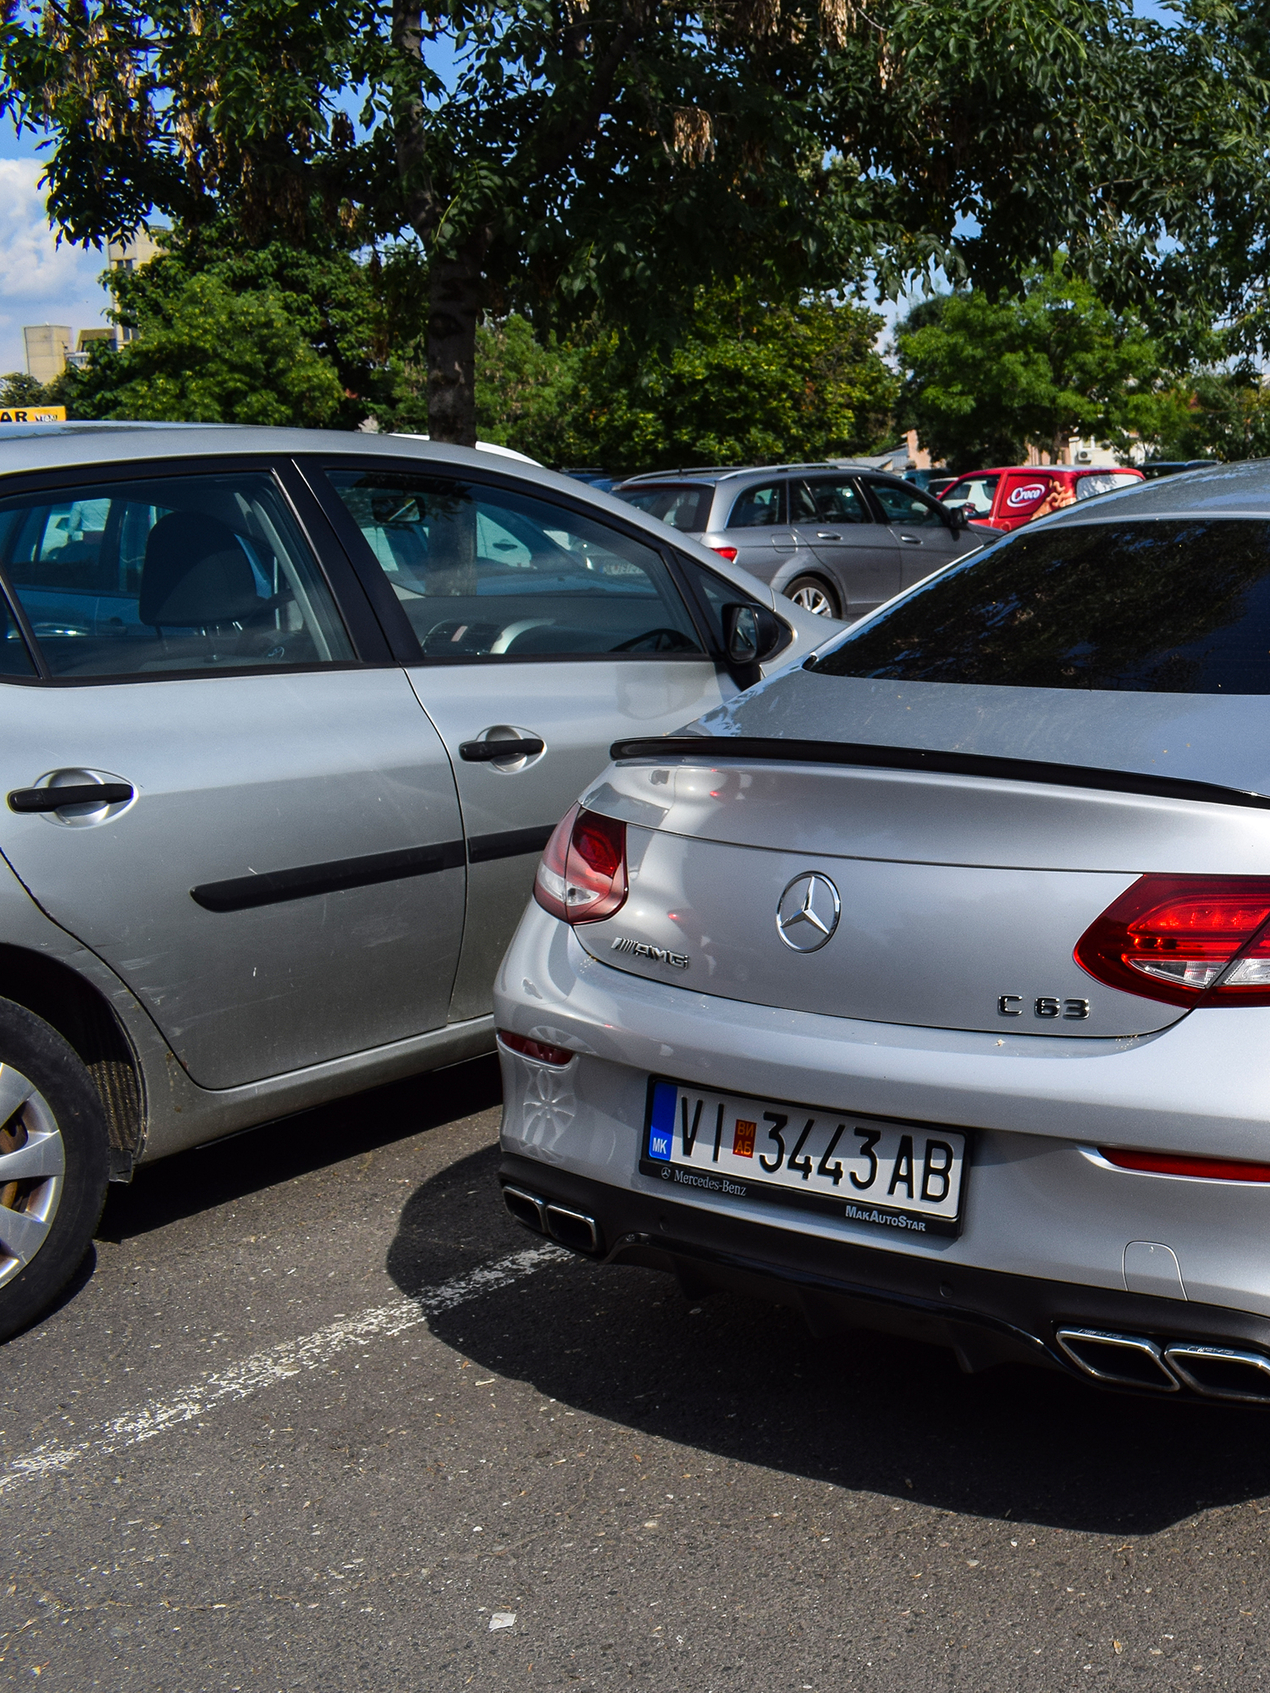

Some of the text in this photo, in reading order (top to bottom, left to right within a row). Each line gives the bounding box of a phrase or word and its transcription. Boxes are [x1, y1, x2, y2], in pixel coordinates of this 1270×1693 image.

[1011, 487, 1041, 502] Croco
[633, 942, 689, 970] AMG
[998, 994, 1090, 1020] C 63
[681, 1095, 725, 1163] VI
[651, 1136, 669, 1154] MK
[673, 1169, 748, 1197] Mercedes-Benz
